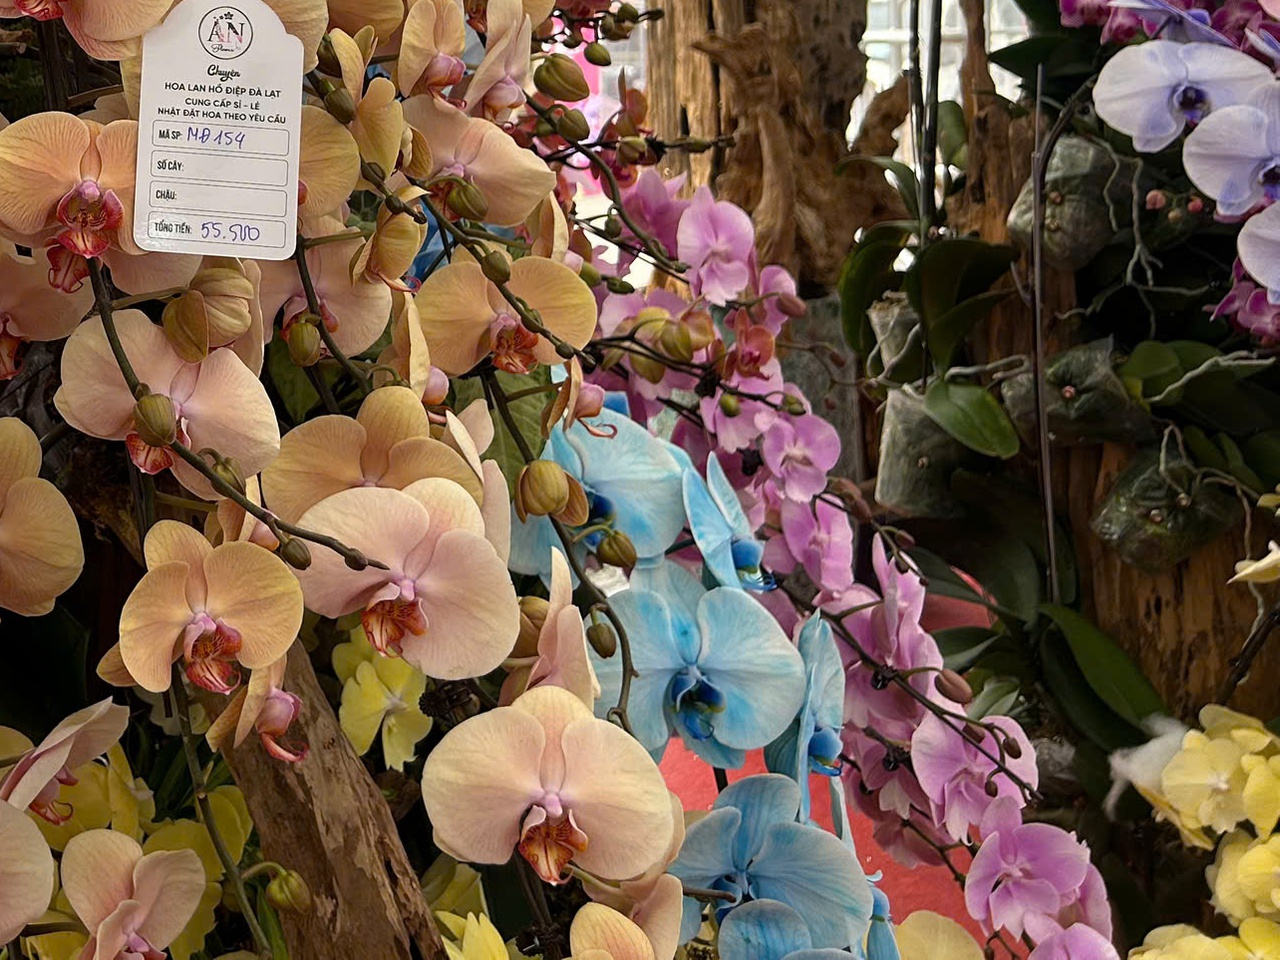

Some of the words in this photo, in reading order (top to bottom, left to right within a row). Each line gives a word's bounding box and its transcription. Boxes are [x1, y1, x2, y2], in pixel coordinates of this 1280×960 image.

[164, 82, 186, 91] HOA
[187, 83, 206, 93] LAN
[225, 86, 247, 97] ĐIỆP
[248, 87, 263, 97] ĐÀ
[264, 89, 282, 99] LẠT
[184, 97, 212, 107] CUNG
[212, 98, 232, 109] CẤP
[201, 110, 222, 119] HOA
[223, 111, 247, 121] THEO
[248, 113, 266, 123] YÊU
